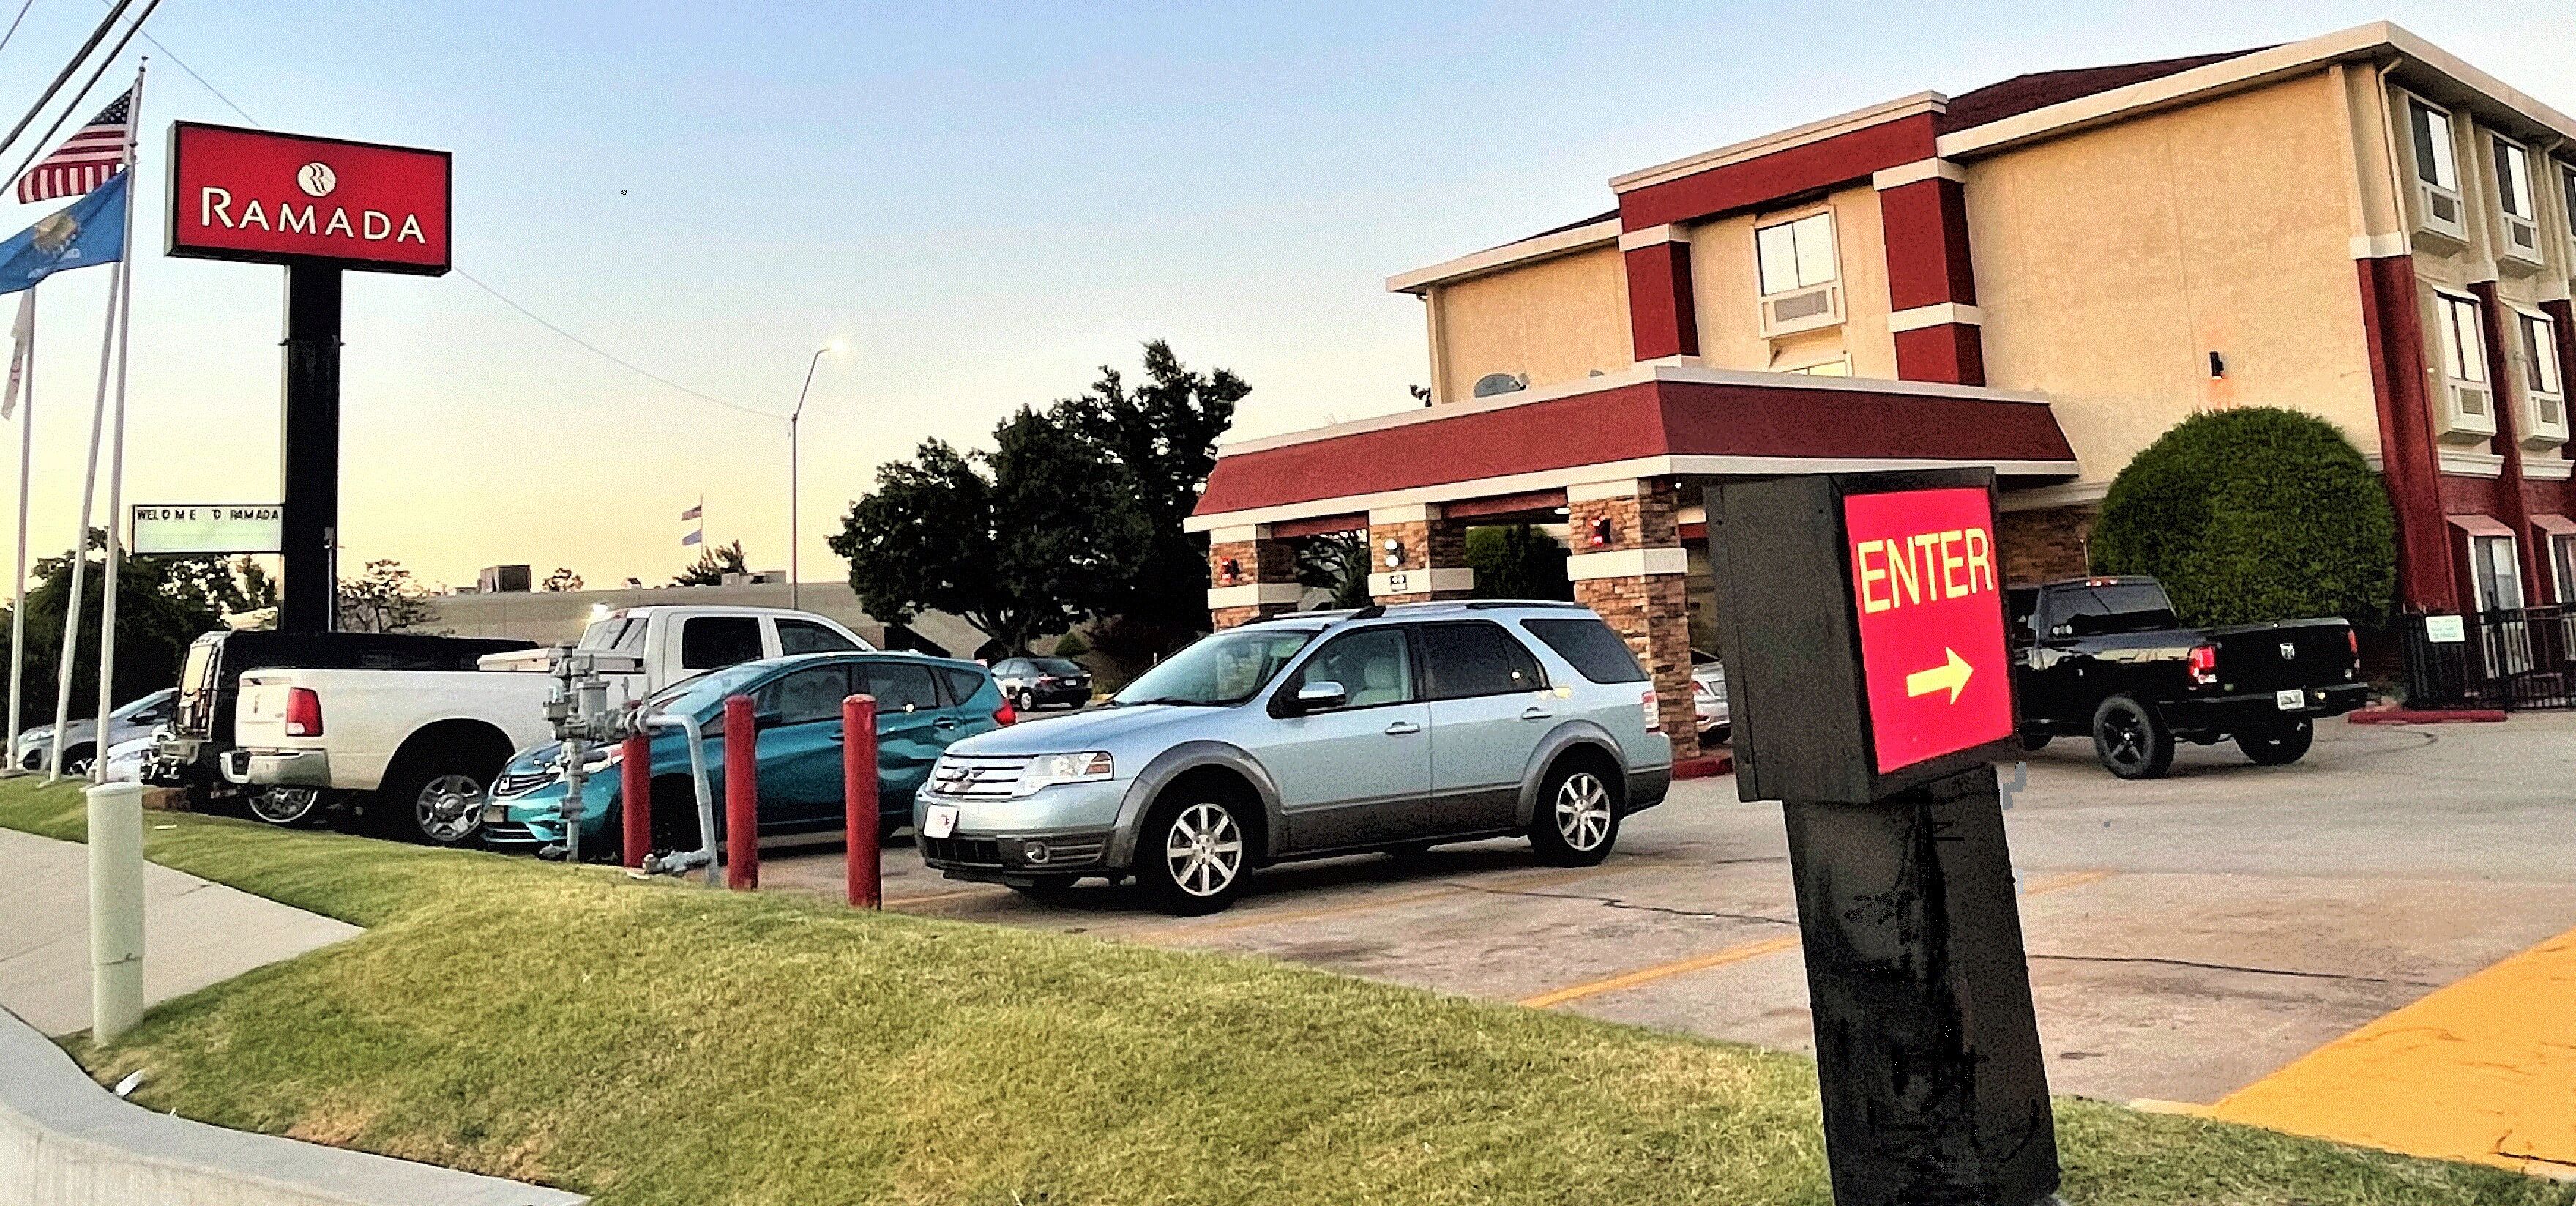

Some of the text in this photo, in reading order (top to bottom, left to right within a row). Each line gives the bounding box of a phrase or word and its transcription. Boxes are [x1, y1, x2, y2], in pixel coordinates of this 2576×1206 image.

[201, 187, 425, 244] RAMADA
[229, 509, 279, 521] RAMADA
[1857, 528, 1993, 614] ENTER
